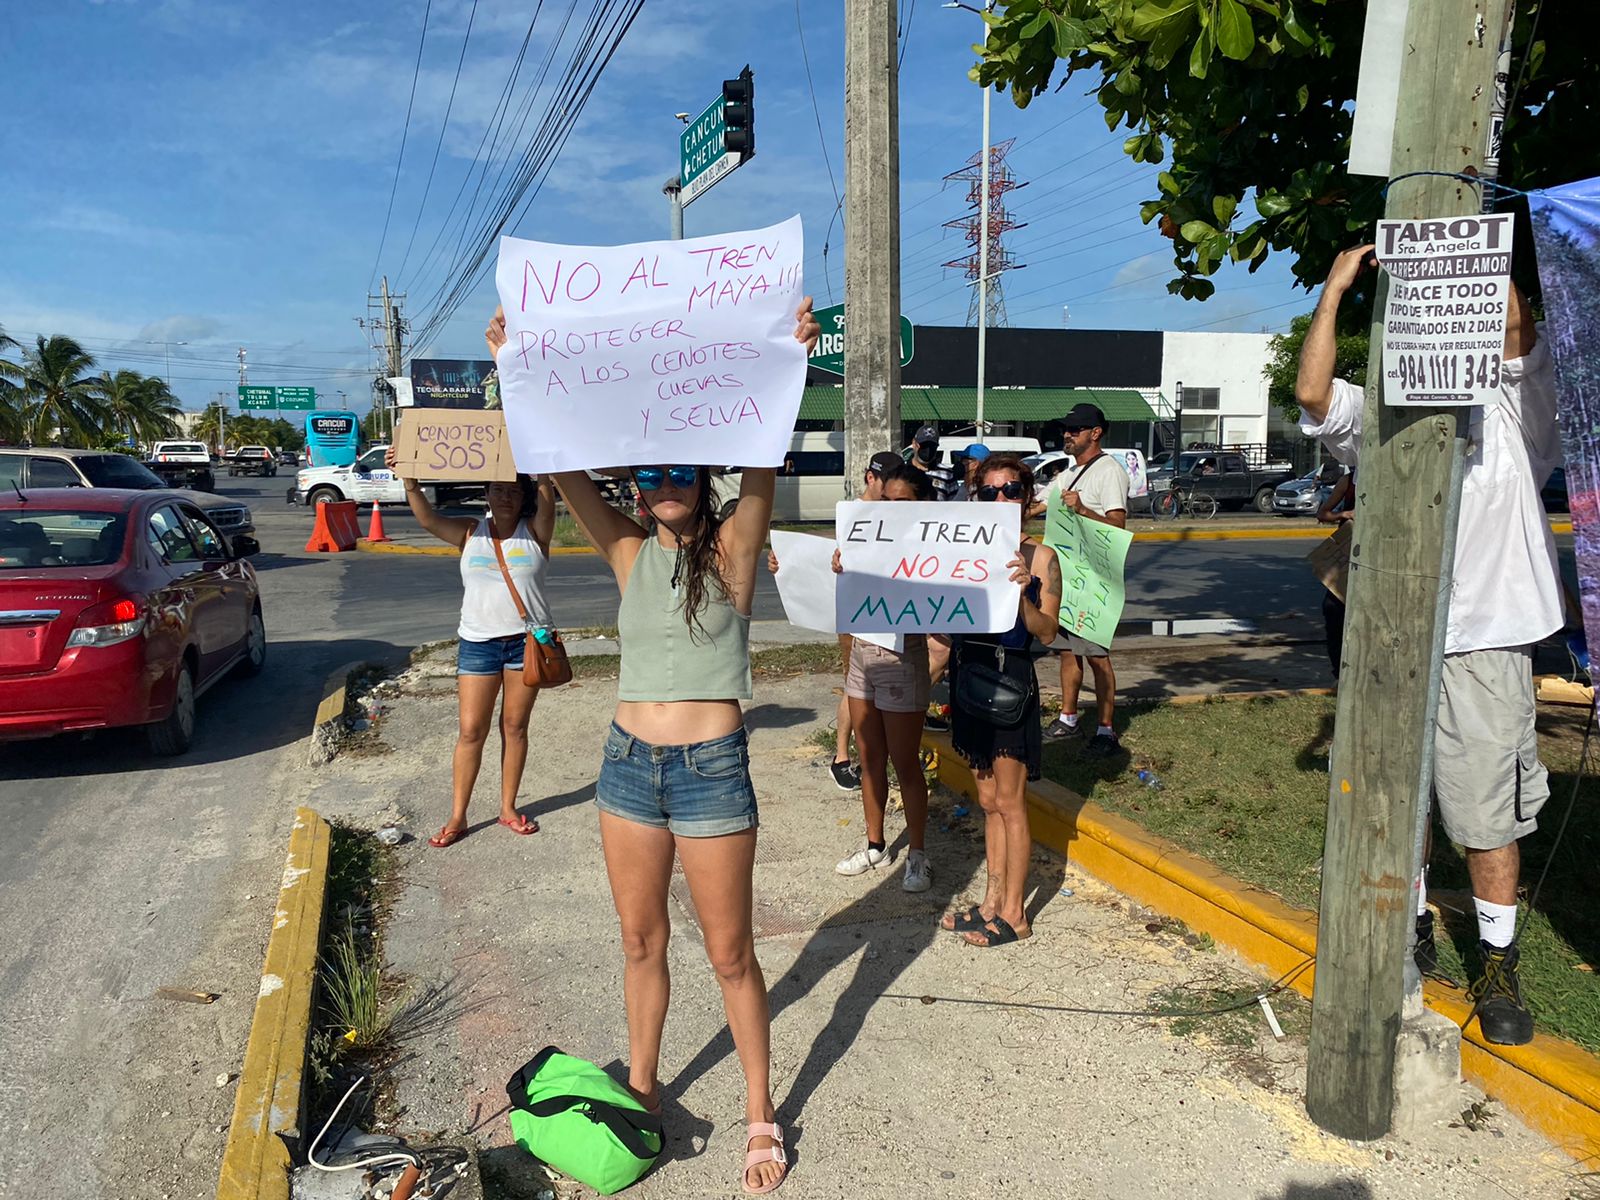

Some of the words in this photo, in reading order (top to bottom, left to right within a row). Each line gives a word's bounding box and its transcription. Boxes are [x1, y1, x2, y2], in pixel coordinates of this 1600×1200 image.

[685, 102, 724, 153] CANCUN
[691, 129, 725, 173] CHETUM
[1380, 217, 1508, 255] TAROT
[1398, 243, 1420, 254] Sra.
[1424, 242, 1480, 254] Angela
[521, 257, 601, 312] NO
[621, 255, 669, 295] AL
[688, 240, 780, 276] TREN
[1385, 261, 1419, 278] MARRES
[1421, 260, 1453, 277] PARA
[1456, 259, 1469, 275] EL
[1472, 256, 1508, 273] AMOR
[1446, 282, 1498, 299] TODO
[1390, 303, 1408, 316] TIPO
[1410, 305, 1421, 318] DE
[1425, 302, 1503, 317] TRABAJOS
[1388, 320, 1448, 334] GARANTIZADOS
[1451, 321, 1465, 334] EN
[1468, 320, 1475, 333] 2
[1477, 320, 1502, 332] DIAS
[516, 319, 696, 370] PROTEGER
[1440, 342, 1454, 350] VER
[1455, 340, 1502, 350] RESULTADOS
[546, 370, 568, 396] A
[580, 362, 630, 385] LOS
[651, 342, 761, 375] CENOTES
[1400, 354, 1426, 390] 984
[1464, 353, 1500, 390] 343
[658, 373, 744, 401] CUEVAS
[641, 408, 650, 438] Y
[664, 396, 762, 432] SELVA
[429, 441, 486, 470] SOS
[847, 520, 894, 542] EL
[920, 521, 998, 546] TREN
[892, 553, 939, 579] NO
[950, 558, 989, 582] ES
[1095, 528, 1114, 581] SELVA
[851, 595, 975, 626] MAYA
